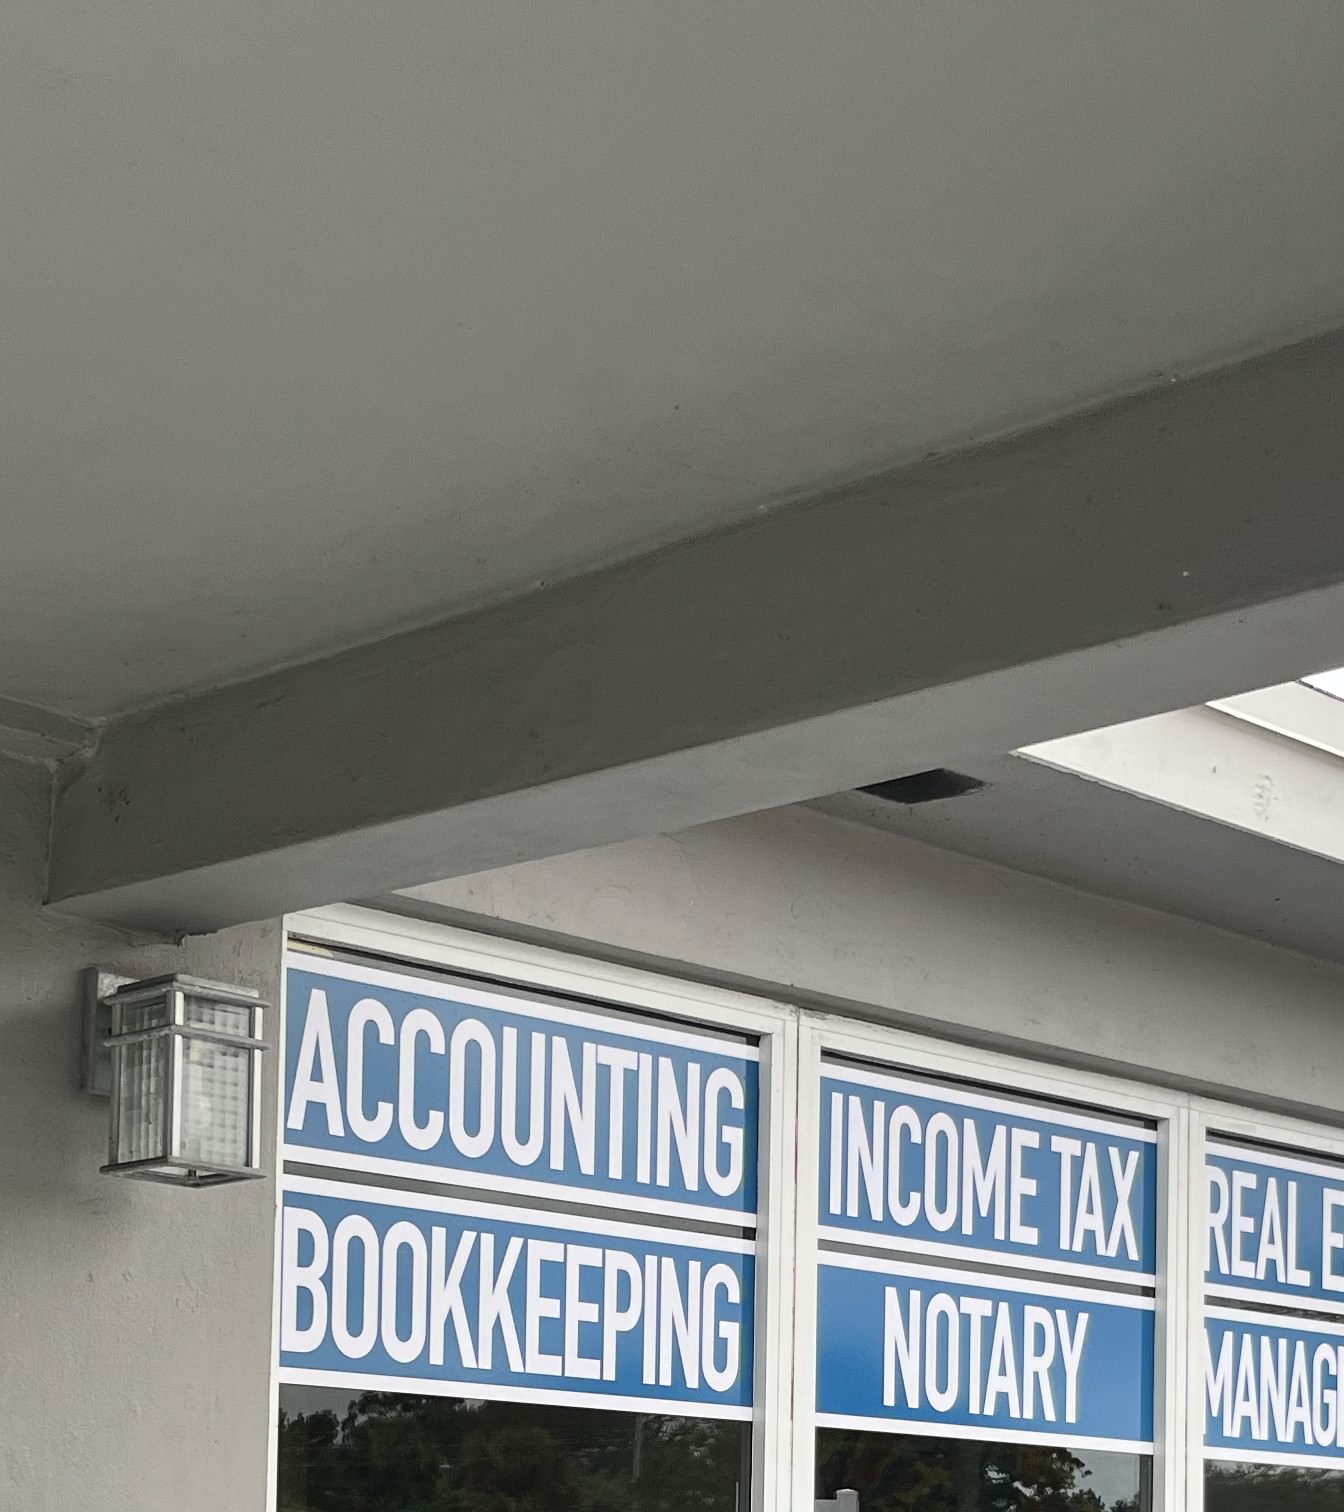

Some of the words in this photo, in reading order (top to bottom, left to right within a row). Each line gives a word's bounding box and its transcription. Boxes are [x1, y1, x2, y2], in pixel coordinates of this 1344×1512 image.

[286, 988, 744, 1197] ACCOUNTING
[829, 1092, 1039, 1246] INCOME
[1051, 1136, 1140, 1260] TAX
[280, 1206, 740, 1392] BOOKKEEPING
[1205, 1165, 1311, 1287] REAL
[883, 1286, 1089, 1423] NOTARY
